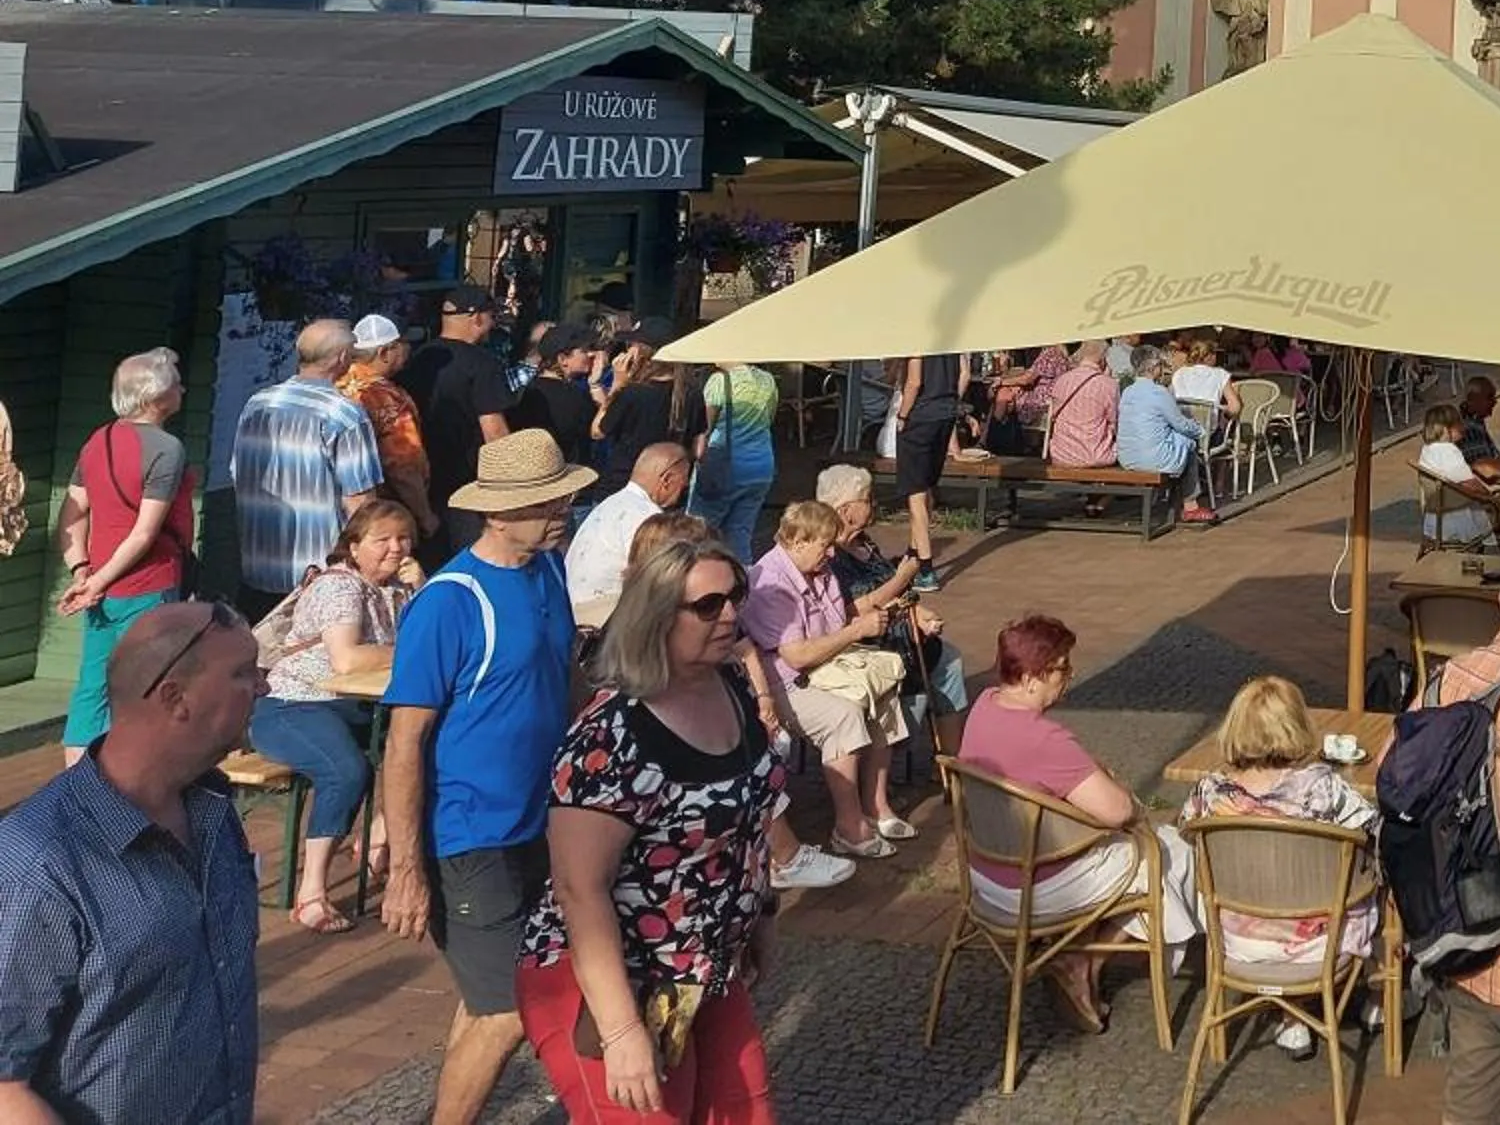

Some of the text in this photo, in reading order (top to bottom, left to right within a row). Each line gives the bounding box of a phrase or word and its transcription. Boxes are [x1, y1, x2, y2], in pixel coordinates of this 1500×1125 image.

[564, 90, 658, 120] U RŮŽOVÉ
[511, 128, 693, 181] ZAHRADY
[1077, 254, 1393, 330] Pilsner Urquell
